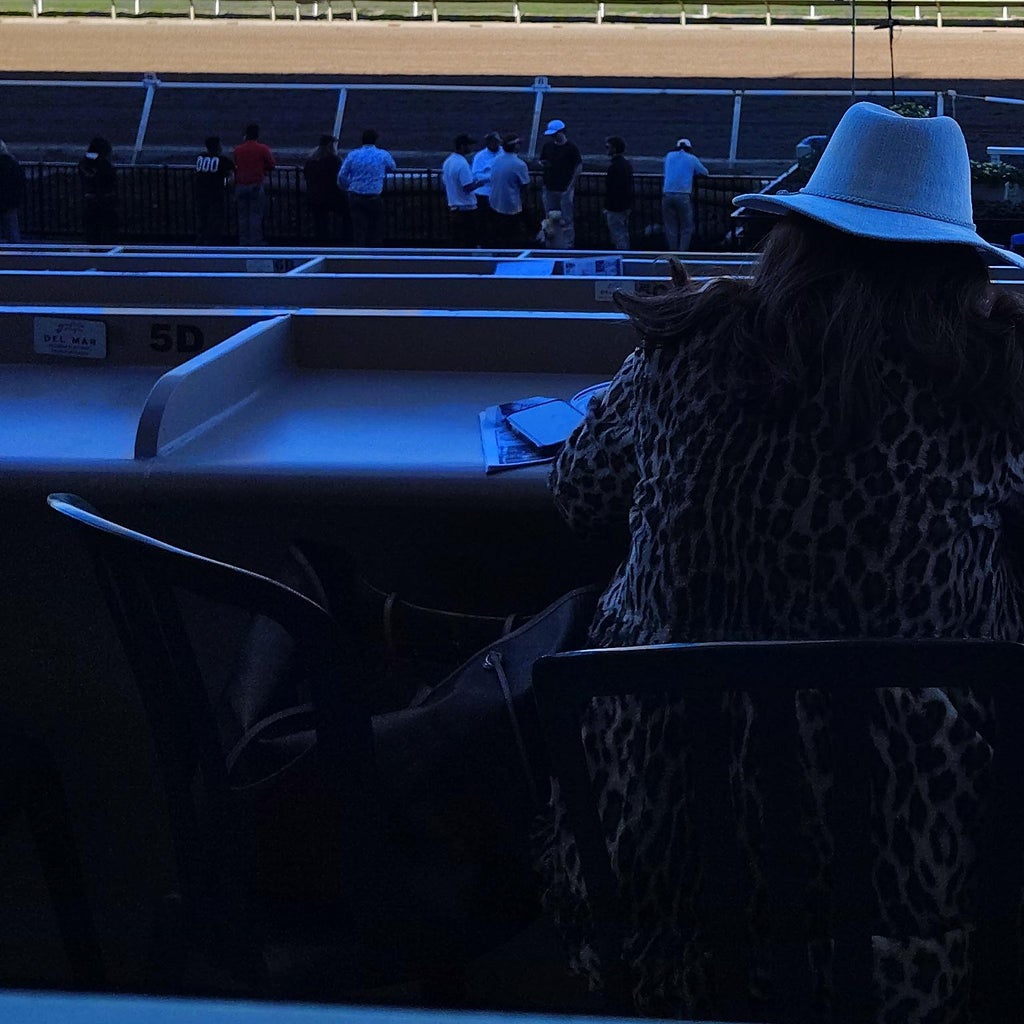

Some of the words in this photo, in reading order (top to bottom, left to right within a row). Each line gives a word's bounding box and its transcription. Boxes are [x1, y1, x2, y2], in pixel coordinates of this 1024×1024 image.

[44, 335, 66, 344] DEL
[72, 337, 96, 346] MAR
[150, 323, 204, 352] 5D
